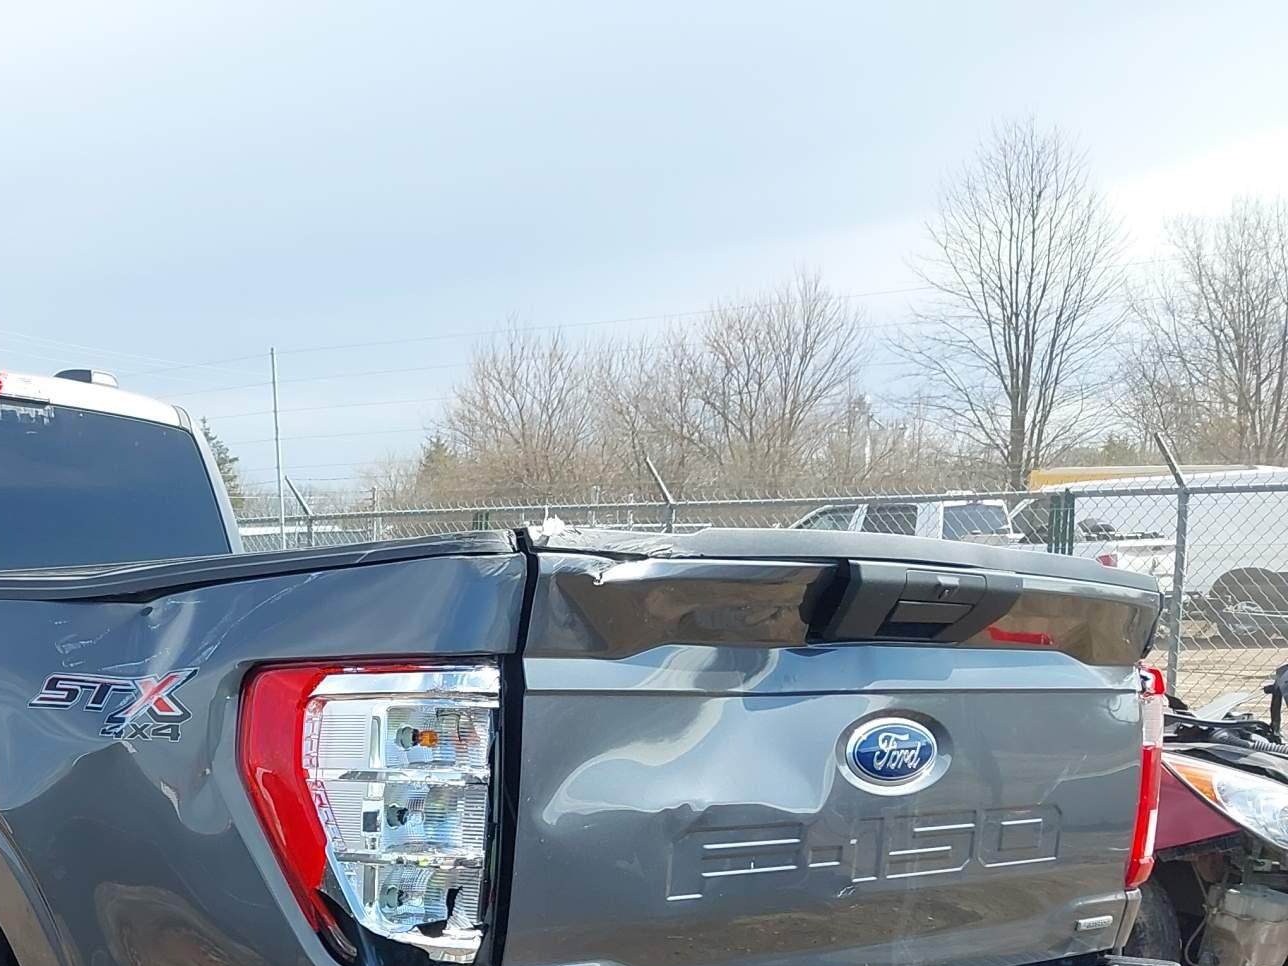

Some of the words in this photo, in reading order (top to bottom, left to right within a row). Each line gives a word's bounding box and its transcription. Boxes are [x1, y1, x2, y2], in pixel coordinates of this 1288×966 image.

[27, 667, 199, 725] STX
[873, 732, 921, 771] Ford
[666, 801, 1063, 902] F-150
